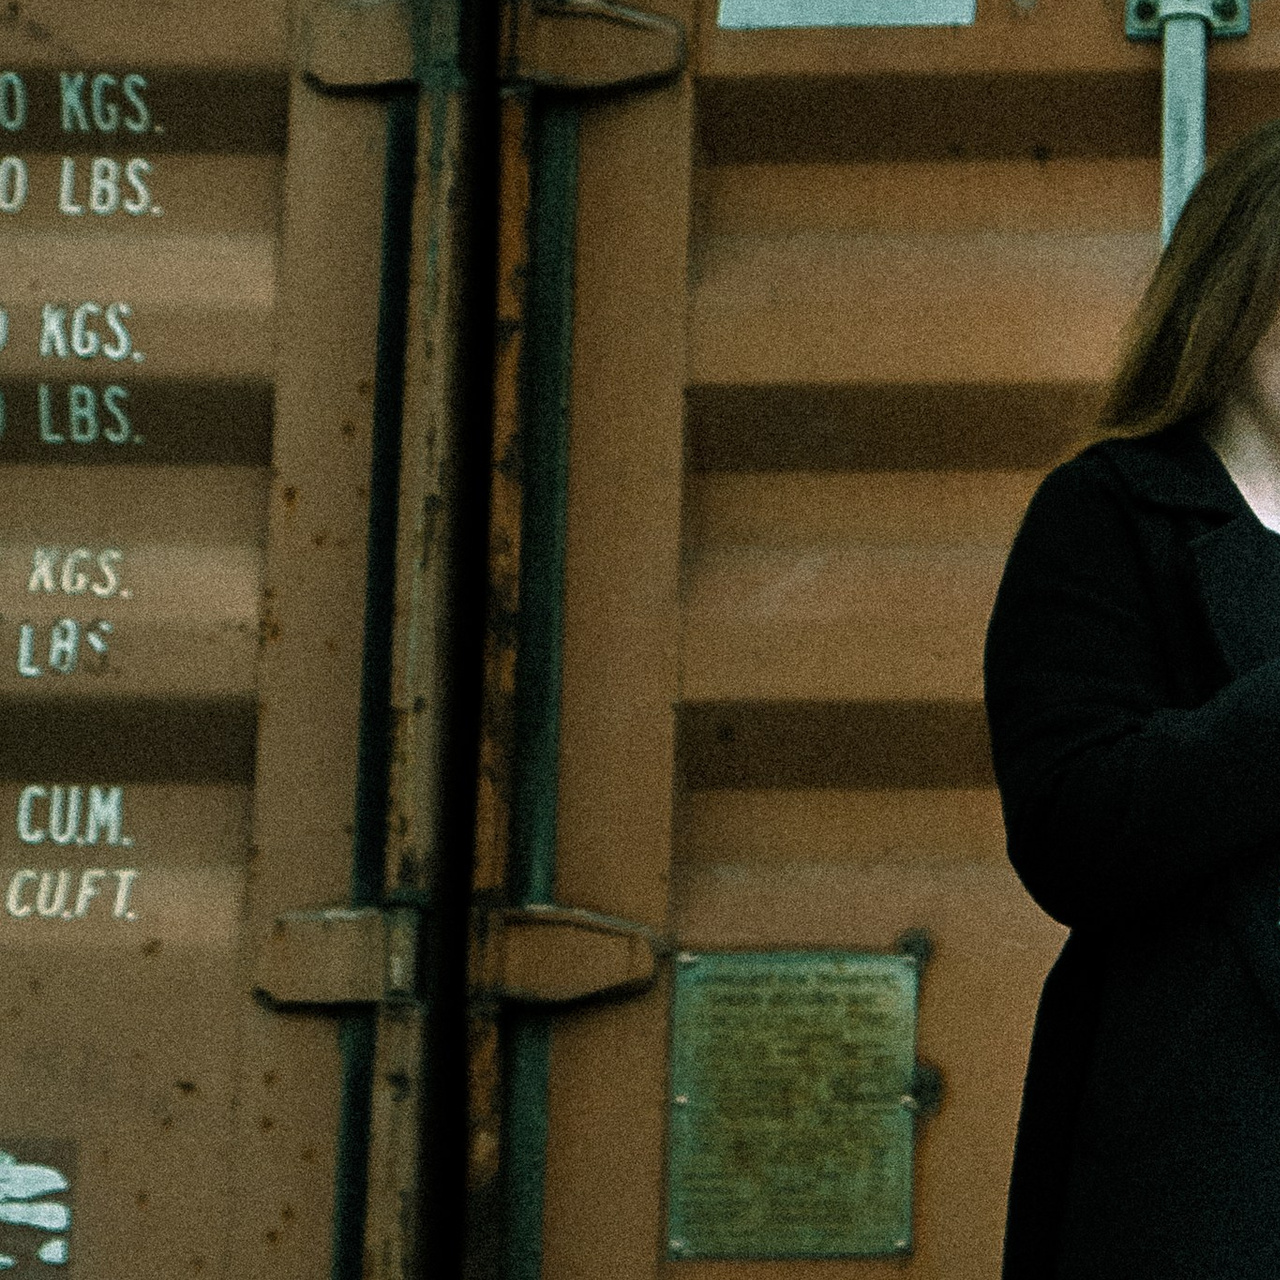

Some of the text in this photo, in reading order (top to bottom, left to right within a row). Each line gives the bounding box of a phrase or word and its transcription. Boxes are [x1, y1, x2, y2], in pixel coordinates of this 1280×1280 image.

[58, 71, 165, 133] KGS.
[58, 157, 165, 217] LBS.
[39, 301, 146, 362] KGS.
[38, 384, 144, 444] LBS.
[28, 547, 132, 599] KGS.
